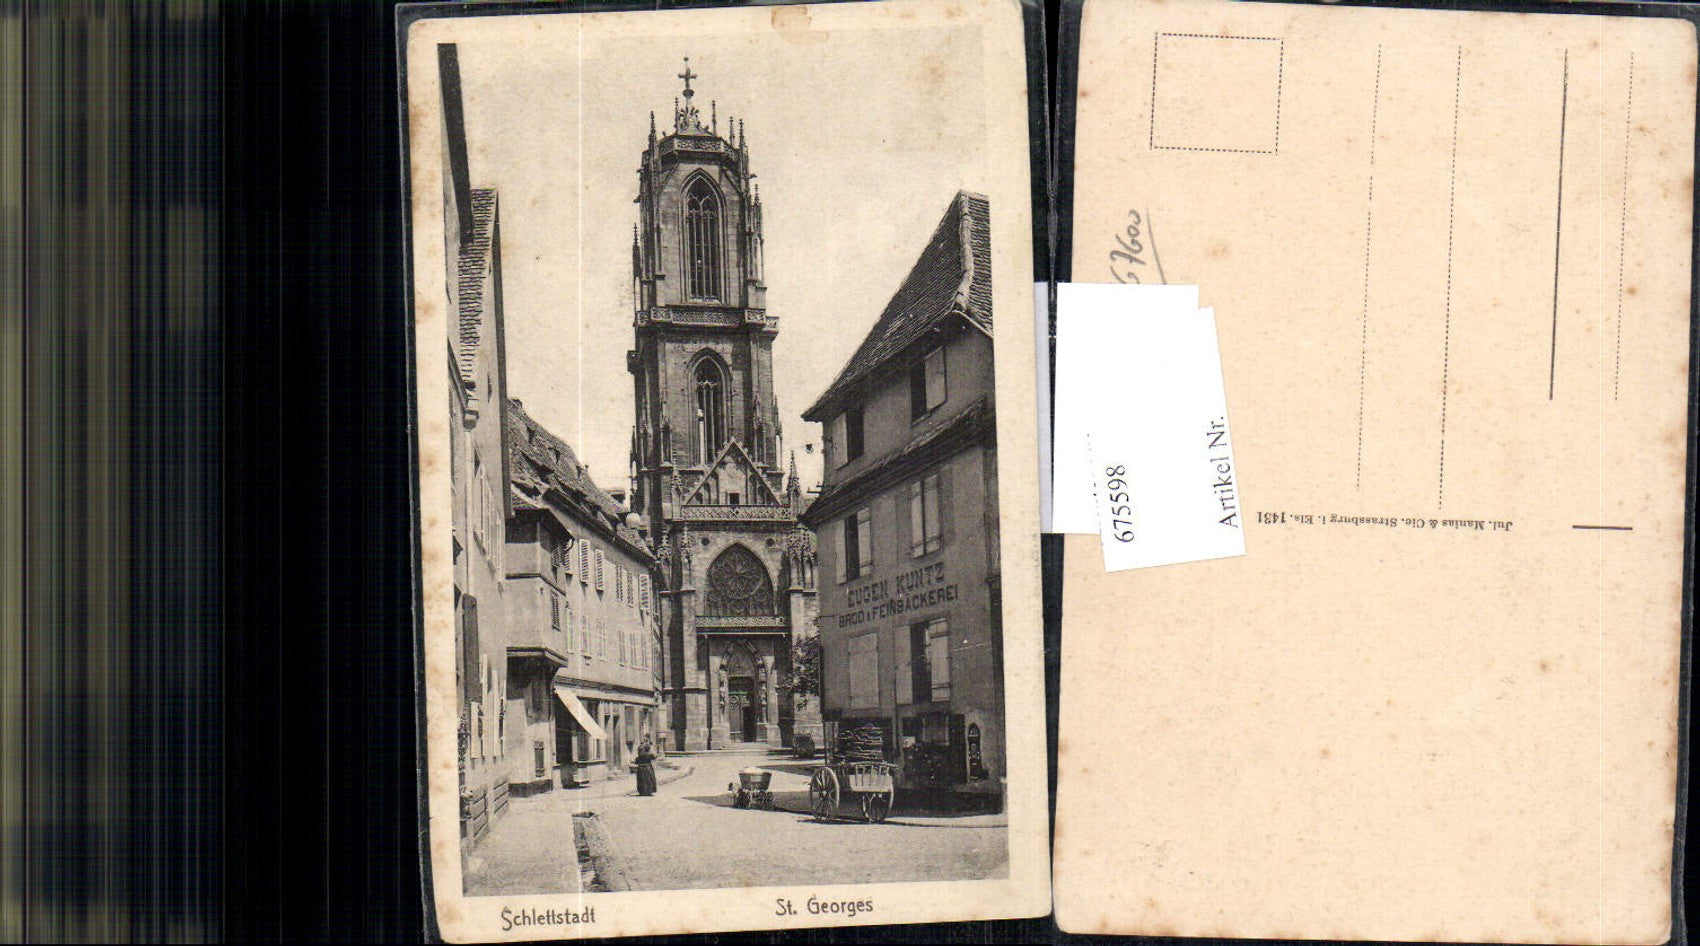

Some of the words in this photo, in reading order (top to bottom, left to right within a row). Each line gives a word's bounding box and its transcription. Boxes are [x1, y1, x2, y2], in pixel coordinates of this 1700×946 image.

[1206, 416, 1228, 449] Nr.
[1210, 456, 1239, 529] Artikel
[1105, 465, 1135, 543] 675598
[1257, 511, 1286, 525] 1431
[1290, 513, 1314, 525] Els.
[1318, 513, 1326, 525] i.
[1329, 513, 1398, 528] Strassburg
[1401, 517, 1425, 529] Cie.
[1429, 518, 1438, 529] &
[1441, 519, 1486, 531] Manias
[1488, 520, 1513, 532] Jul.
[847, 579, 889, 609] EUGEN
[896, 561, 945, 594] KUNTZ
[839, 609, 865, 628] BROD
[775, 898, 798, 917] St.
[807, 894, 874, 918] Georges
[501, 906, 597, 932] Schlettstadt
